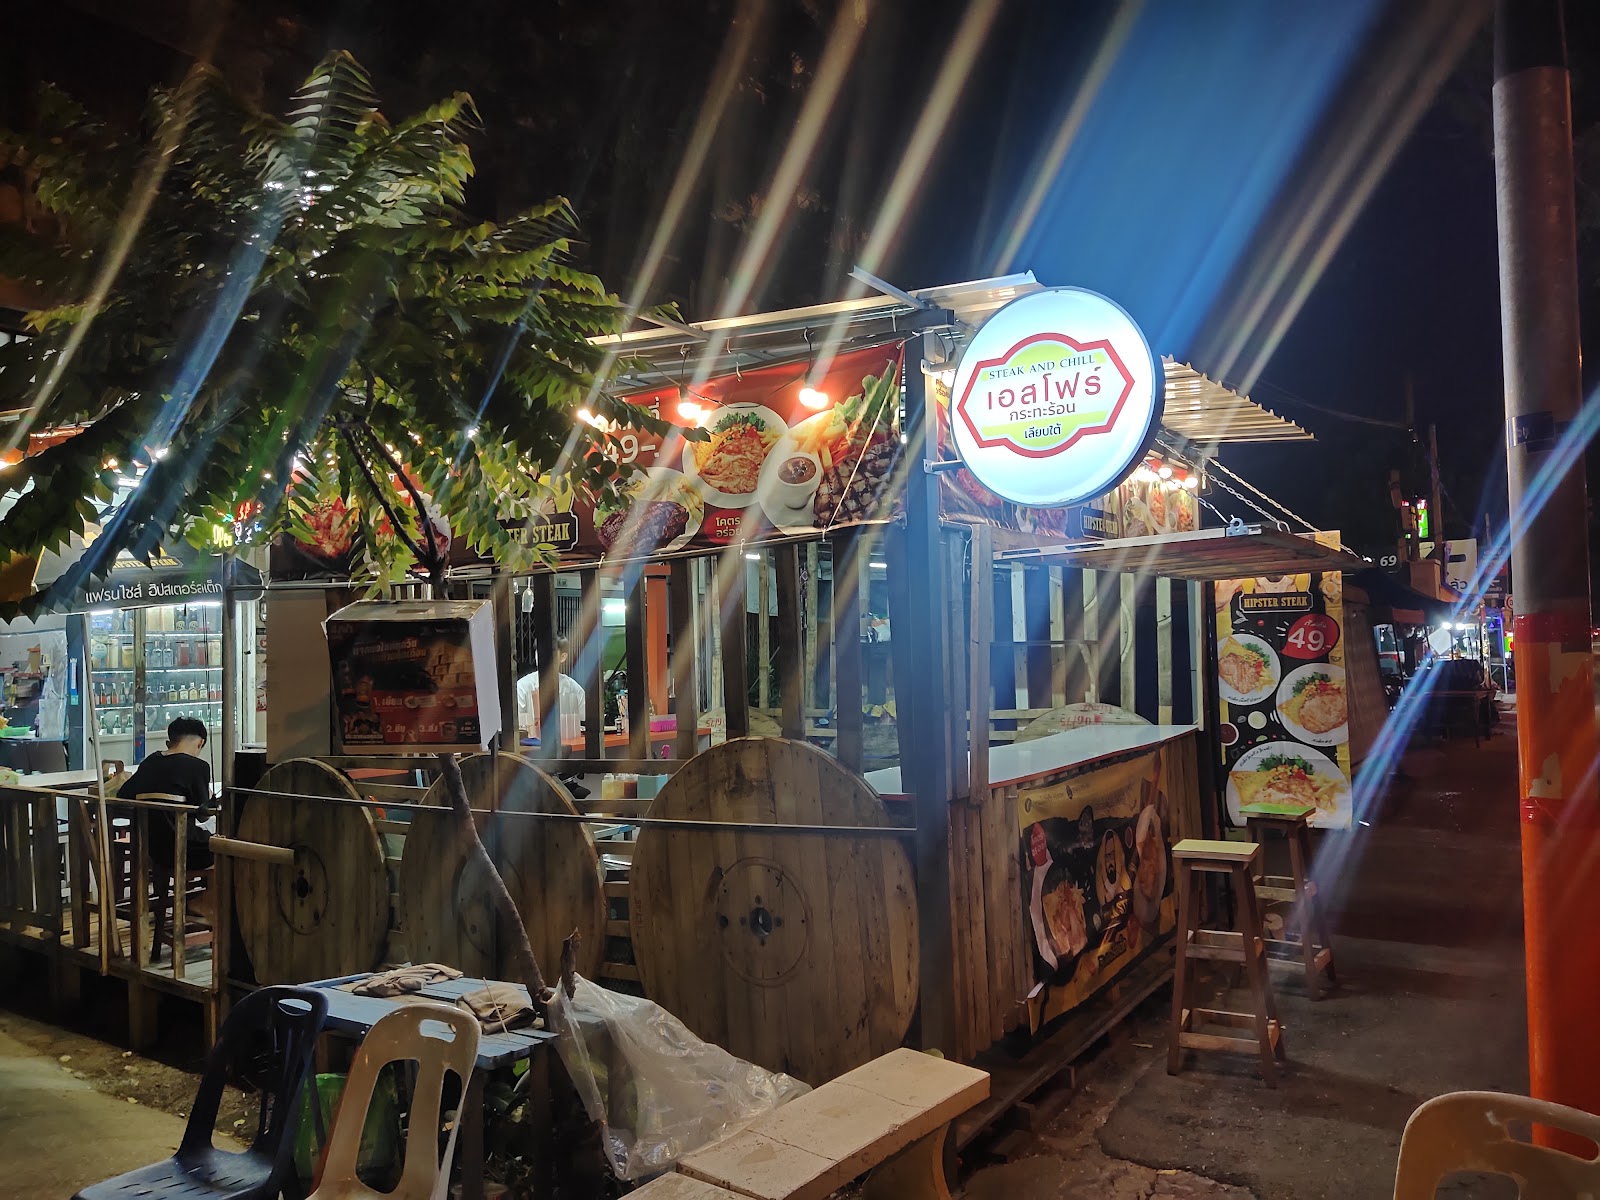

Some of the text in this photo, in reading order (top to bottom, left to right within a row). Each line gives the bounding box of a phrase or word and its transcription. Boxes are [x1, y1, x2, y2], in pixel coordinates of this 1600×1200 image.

[989, 354, 1095, 380] STEAK AND CHILL
[988, 366, 1101, 410] เอสโฟร์
[1009, 401, 1076, 421] กระทะร้อน
[1024, 423, 1062, 439] เลียบใต้
[532, 522, 571, 543] STEAK
[1379, 554, 1398, 567] 69
[1244, 596, 1308, 608] HIPSTER STEAK
